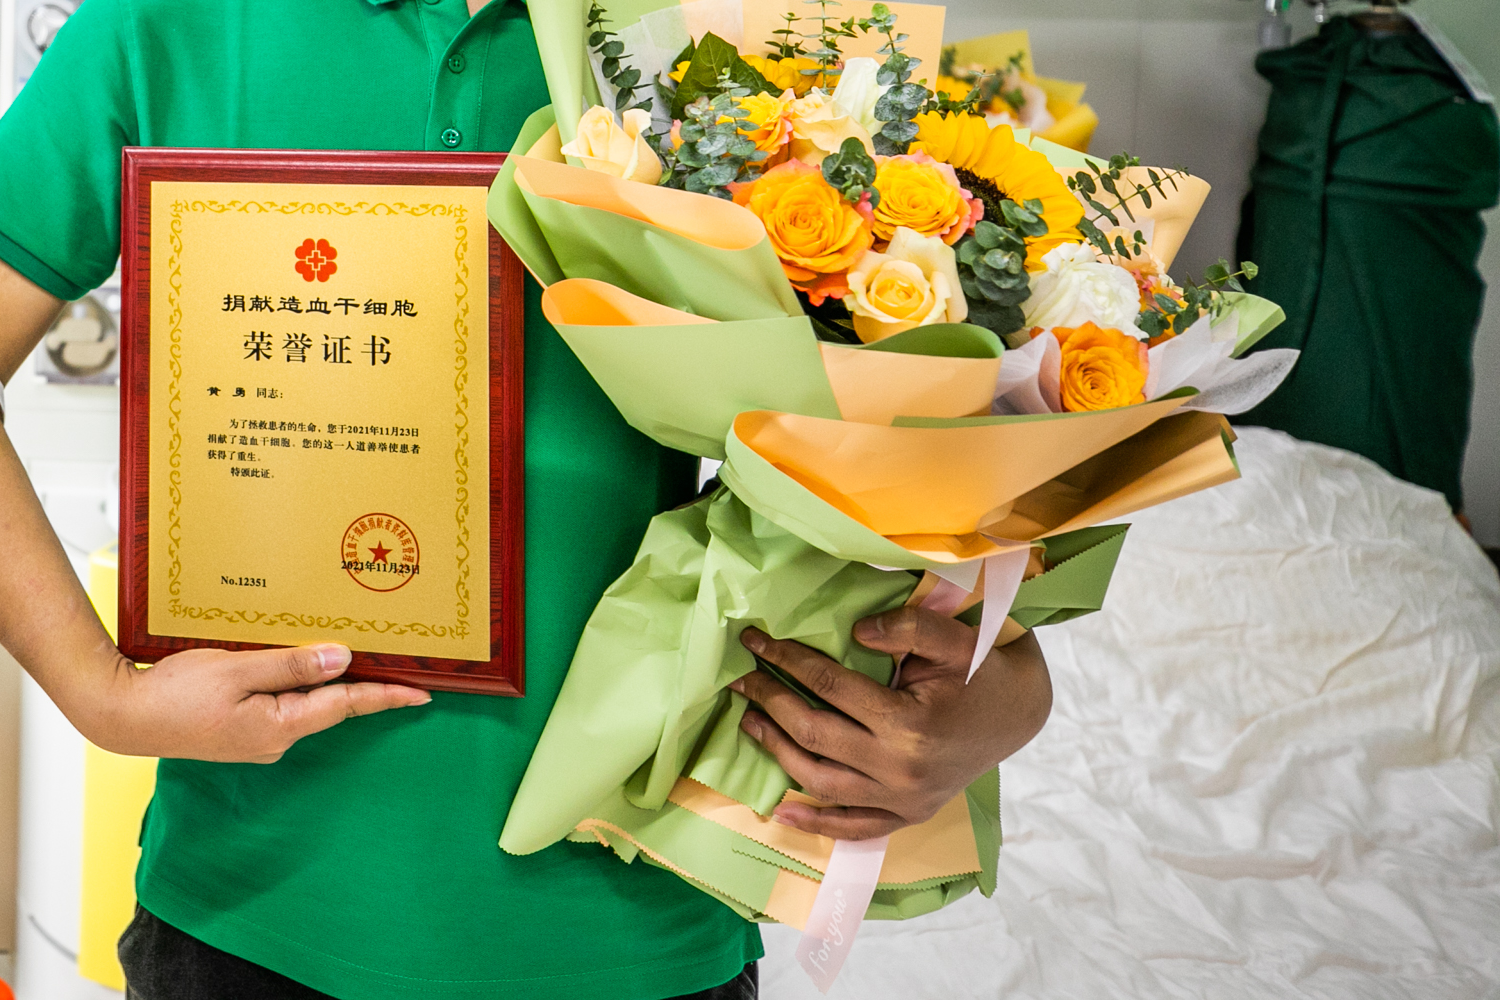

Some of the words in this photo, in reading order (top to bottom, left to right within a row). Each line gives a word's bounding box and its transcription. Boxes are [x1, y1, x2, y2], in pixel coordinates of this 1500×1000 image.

[221, 294, 418, 317] 捐献造血干细胞
[244, 331, 391, 366] 荣誉证书
[341, 560, 420, 575] 2021年11月23日
[221, 576, 266, 587] No.12351
[808, 936, 830, 978] for
[827, 898, 847, 946] you
